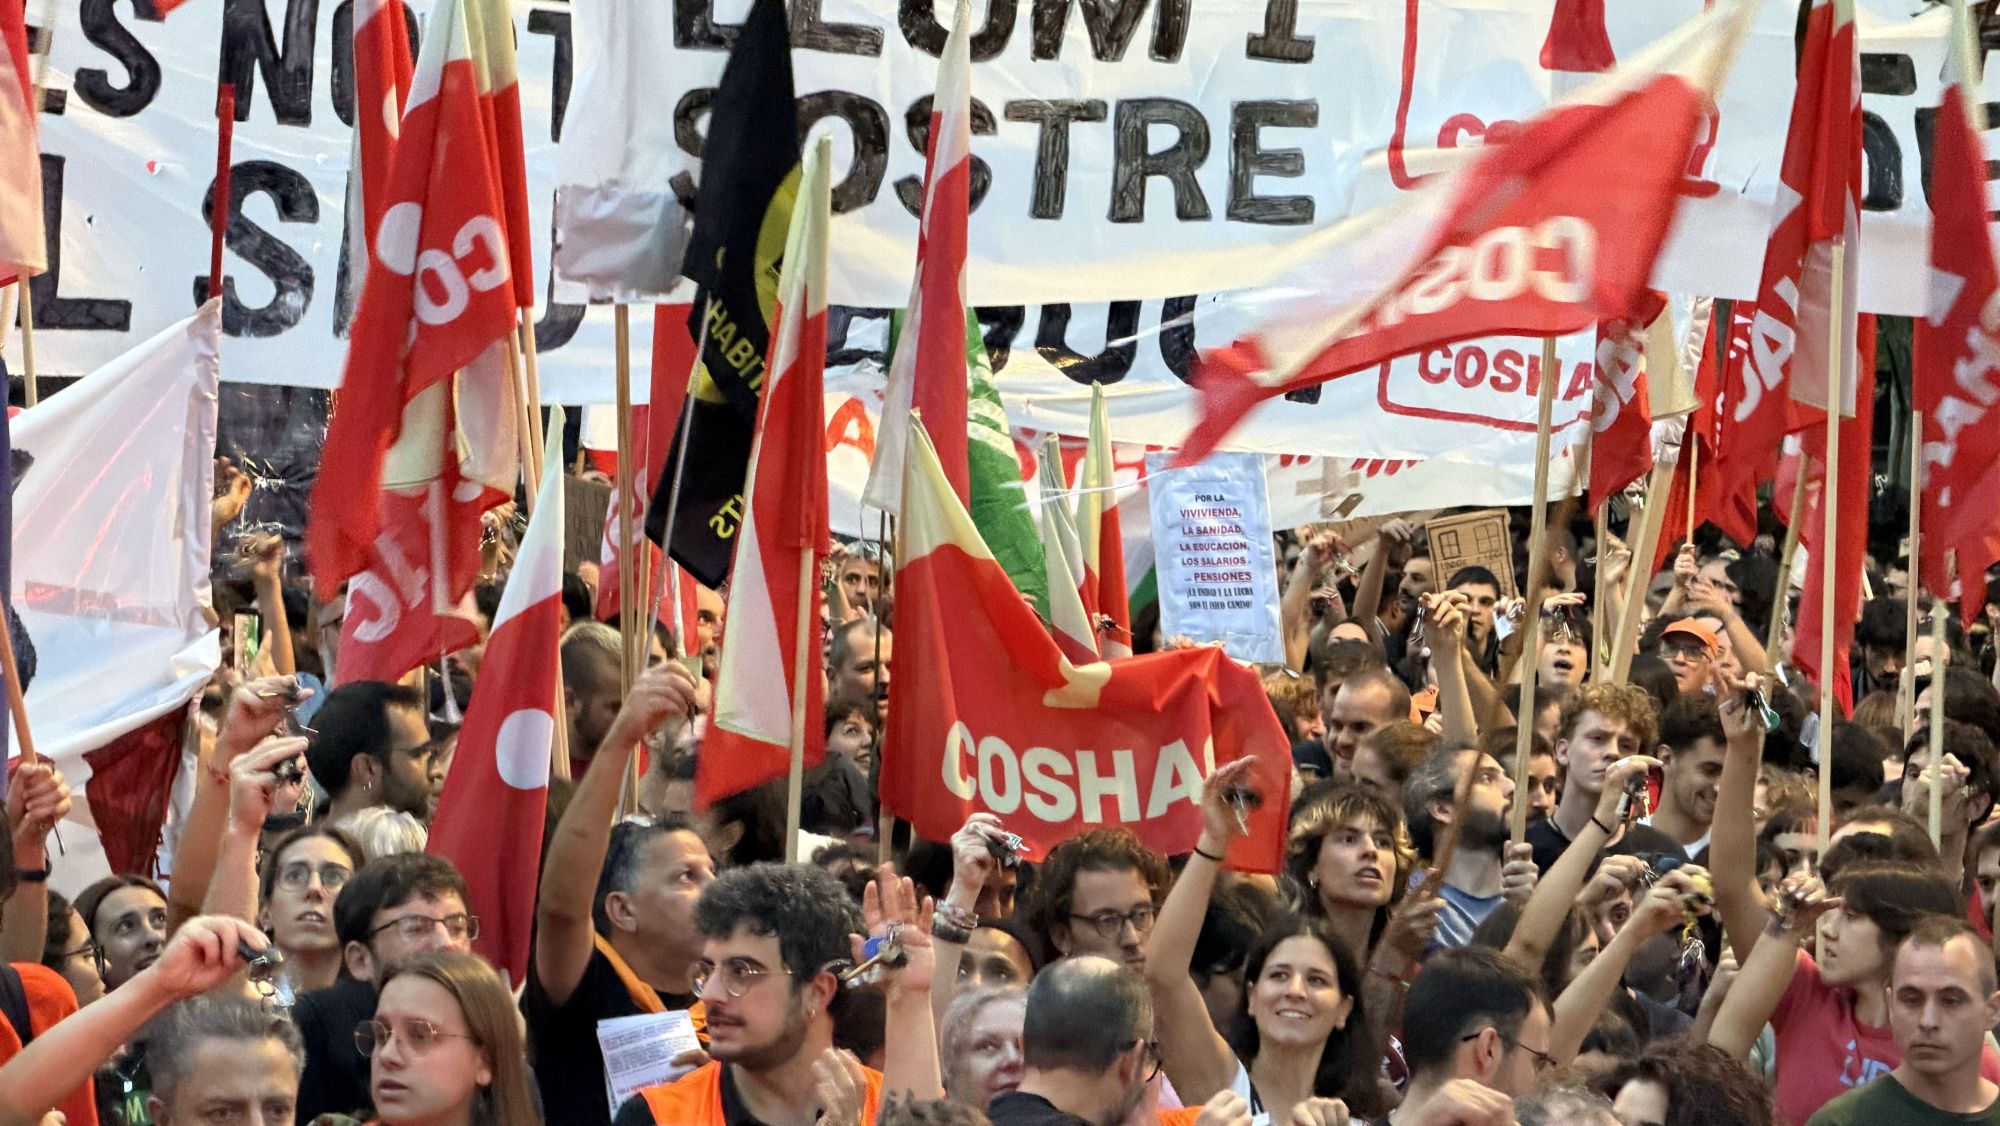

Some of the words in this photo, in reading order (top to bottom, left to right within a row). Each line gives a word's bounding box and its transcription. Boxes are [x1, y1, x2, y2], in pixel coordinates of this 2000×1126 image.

[669, 87, 1319, 226] SOSTRE
[1195, 494, 1212, 502] POR
[1213, 494, 1225, 502] LA
[1182, 526, 1192, 535] LA
[1180, 544, 1192, 552] LA
[1182, 557, 1199, 566] LOS
[1194, 572, 1252, 581] PENSIONES
[942, 720, 1216, 823] COSHA
